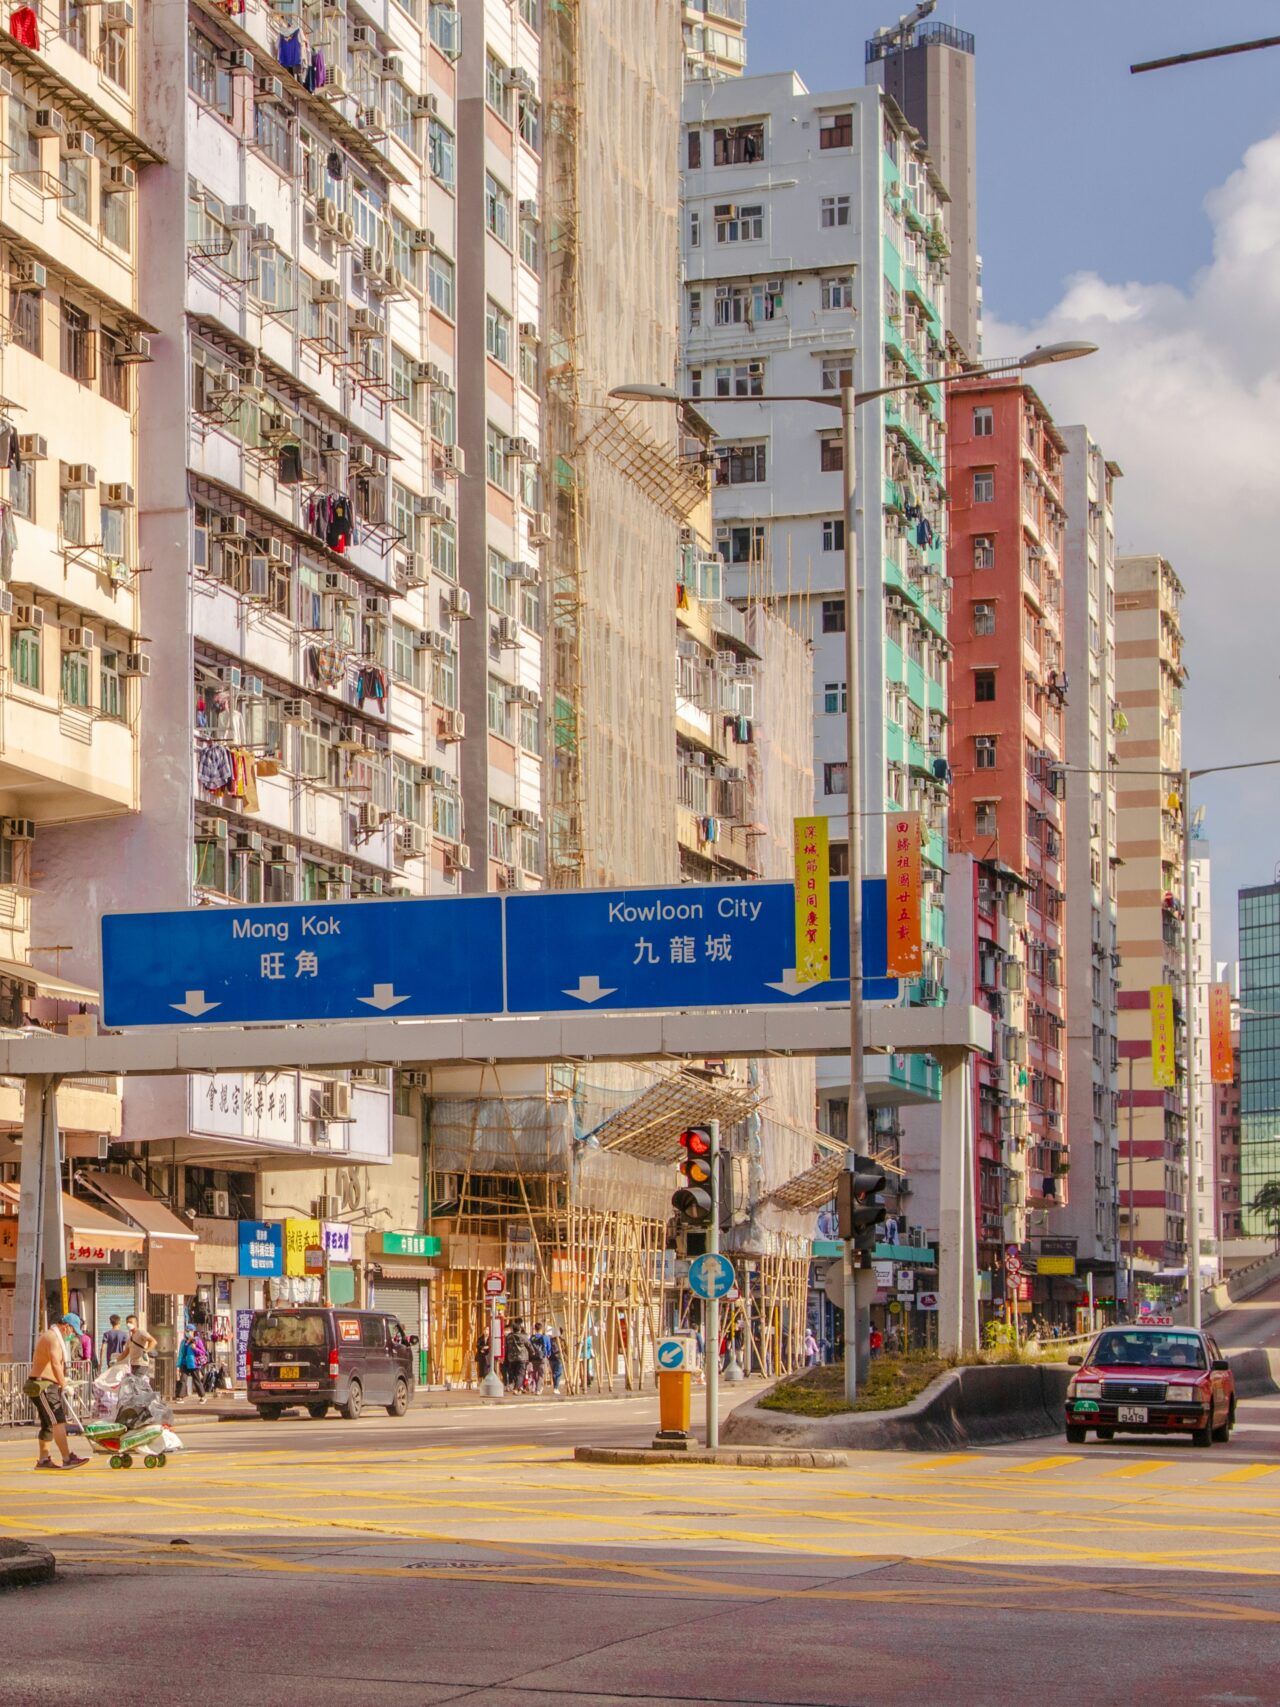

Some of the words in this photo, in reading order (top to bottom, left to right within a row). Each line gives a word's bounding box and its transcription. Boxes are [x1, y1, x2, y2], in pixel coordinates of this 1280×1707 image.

[609, 900, 703, 923] Kowloon
[717, 897, 763, 921] City
[232, 918, 289, 941] Mong
[301, 915, 341, 936] Kok
[632, 934, 733, 965] 九龍城
[260, 949, 319, 980] 旺角
[1139, 1316, 1171, 1325] TAXI
[1127, 1407, 1139, 1416] TL
